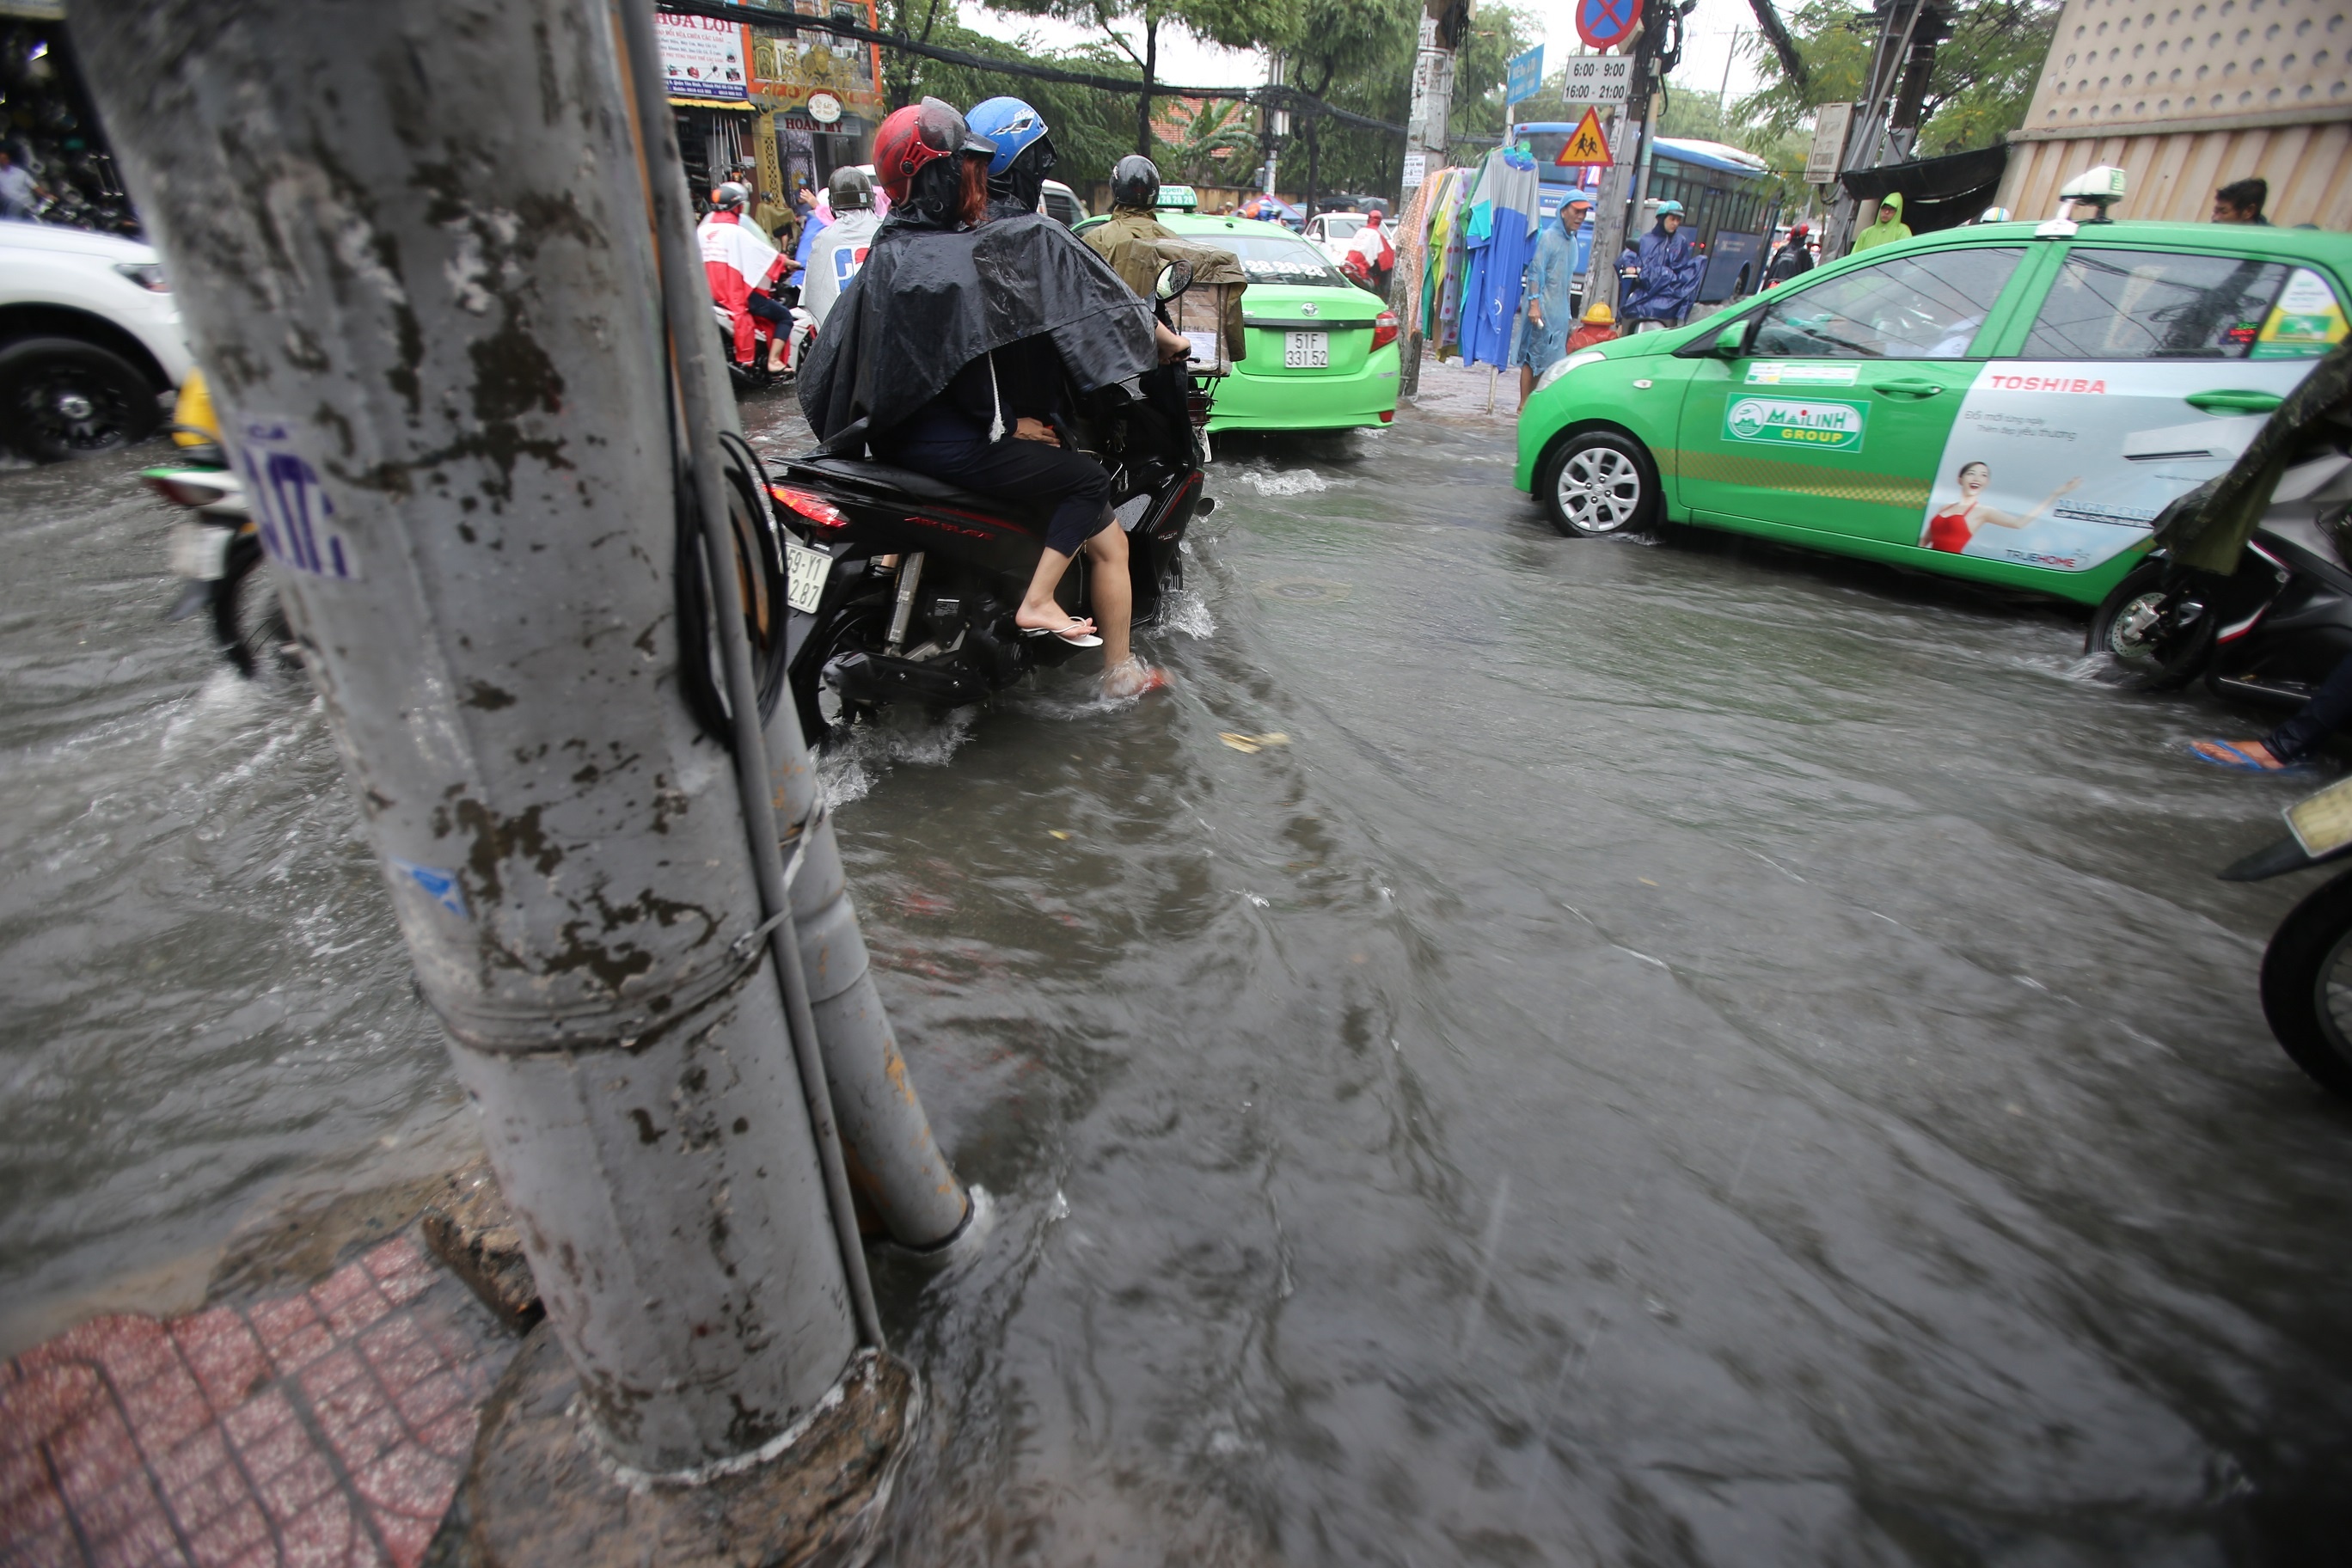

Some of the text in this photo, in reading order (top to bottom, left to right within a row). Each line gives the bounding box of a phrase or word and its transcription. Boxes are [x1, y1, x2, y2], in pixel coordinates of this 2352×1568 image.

[1573, 63, 1595, 77] 6:00
[1603, 63, 1625, 77] 9:00
[1565, 84, 1589, 98] 16:00
[1599, 84, 1624, 99] 21:00
[1245, 260, 1327, 278] 28 28 28
[1295, 333, 1319, 349] 51F
[1286, 350, 1327, 365] 331.52
[1991, 375, 2106, 395] TOSHIBA
[1781, 428, 1843, 443] GROUP
[2006, 548, 2075, 567] TRUEHOME
[788, 579, 819, 608] 2.87
